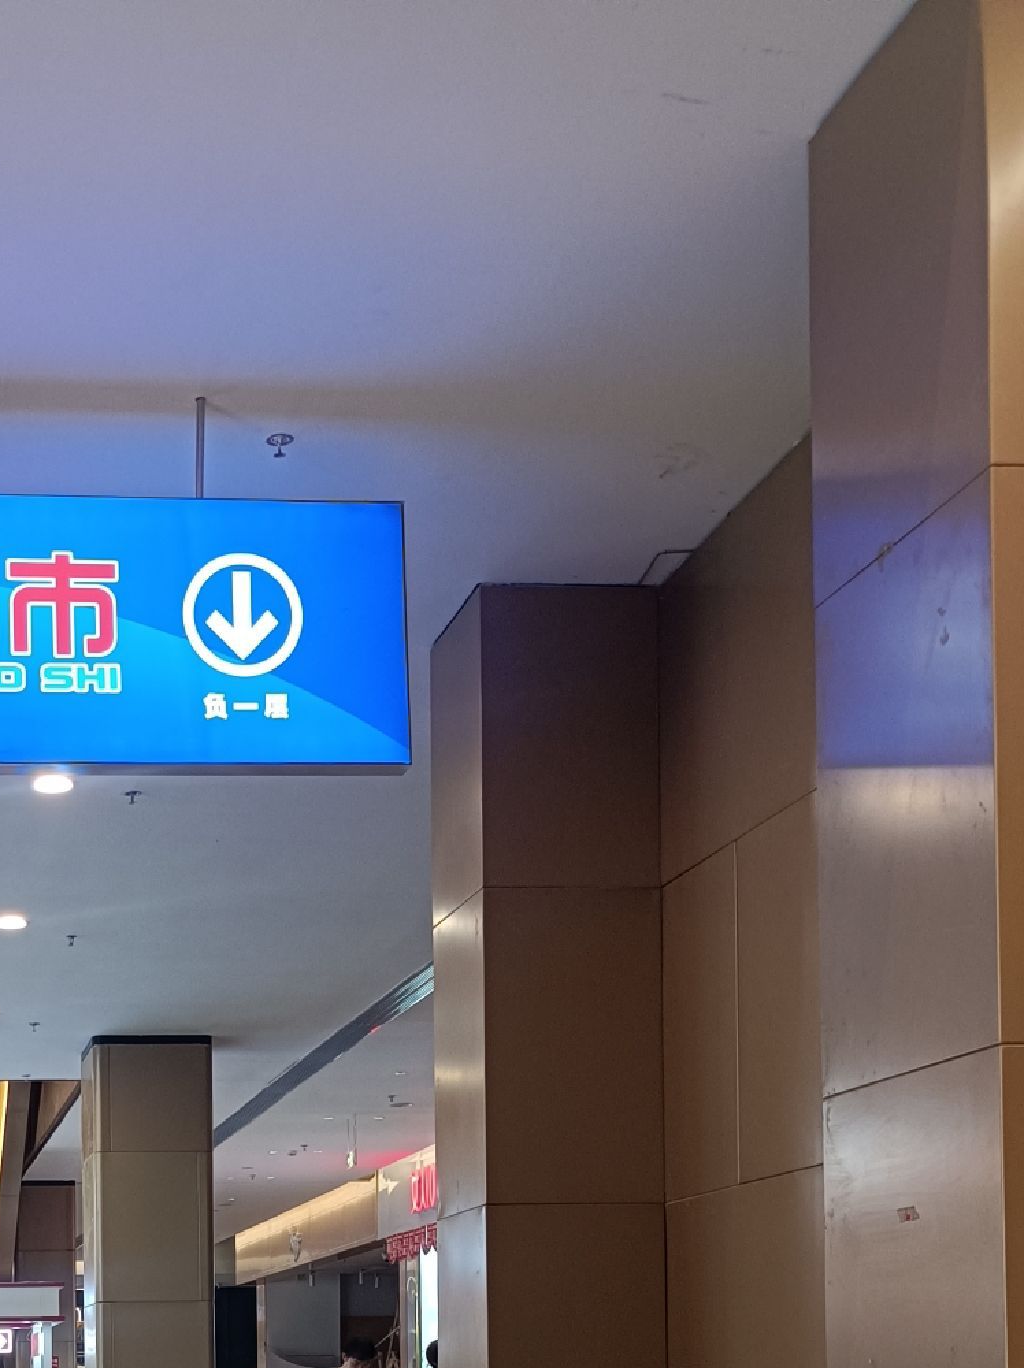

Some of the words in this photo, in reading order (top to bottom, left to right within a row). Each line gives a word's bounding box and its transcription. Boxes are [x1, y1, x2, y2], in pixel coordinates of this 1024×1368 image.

[39, 661, 122, 694] SHI
[203, 692, 290, 719] 负一层
